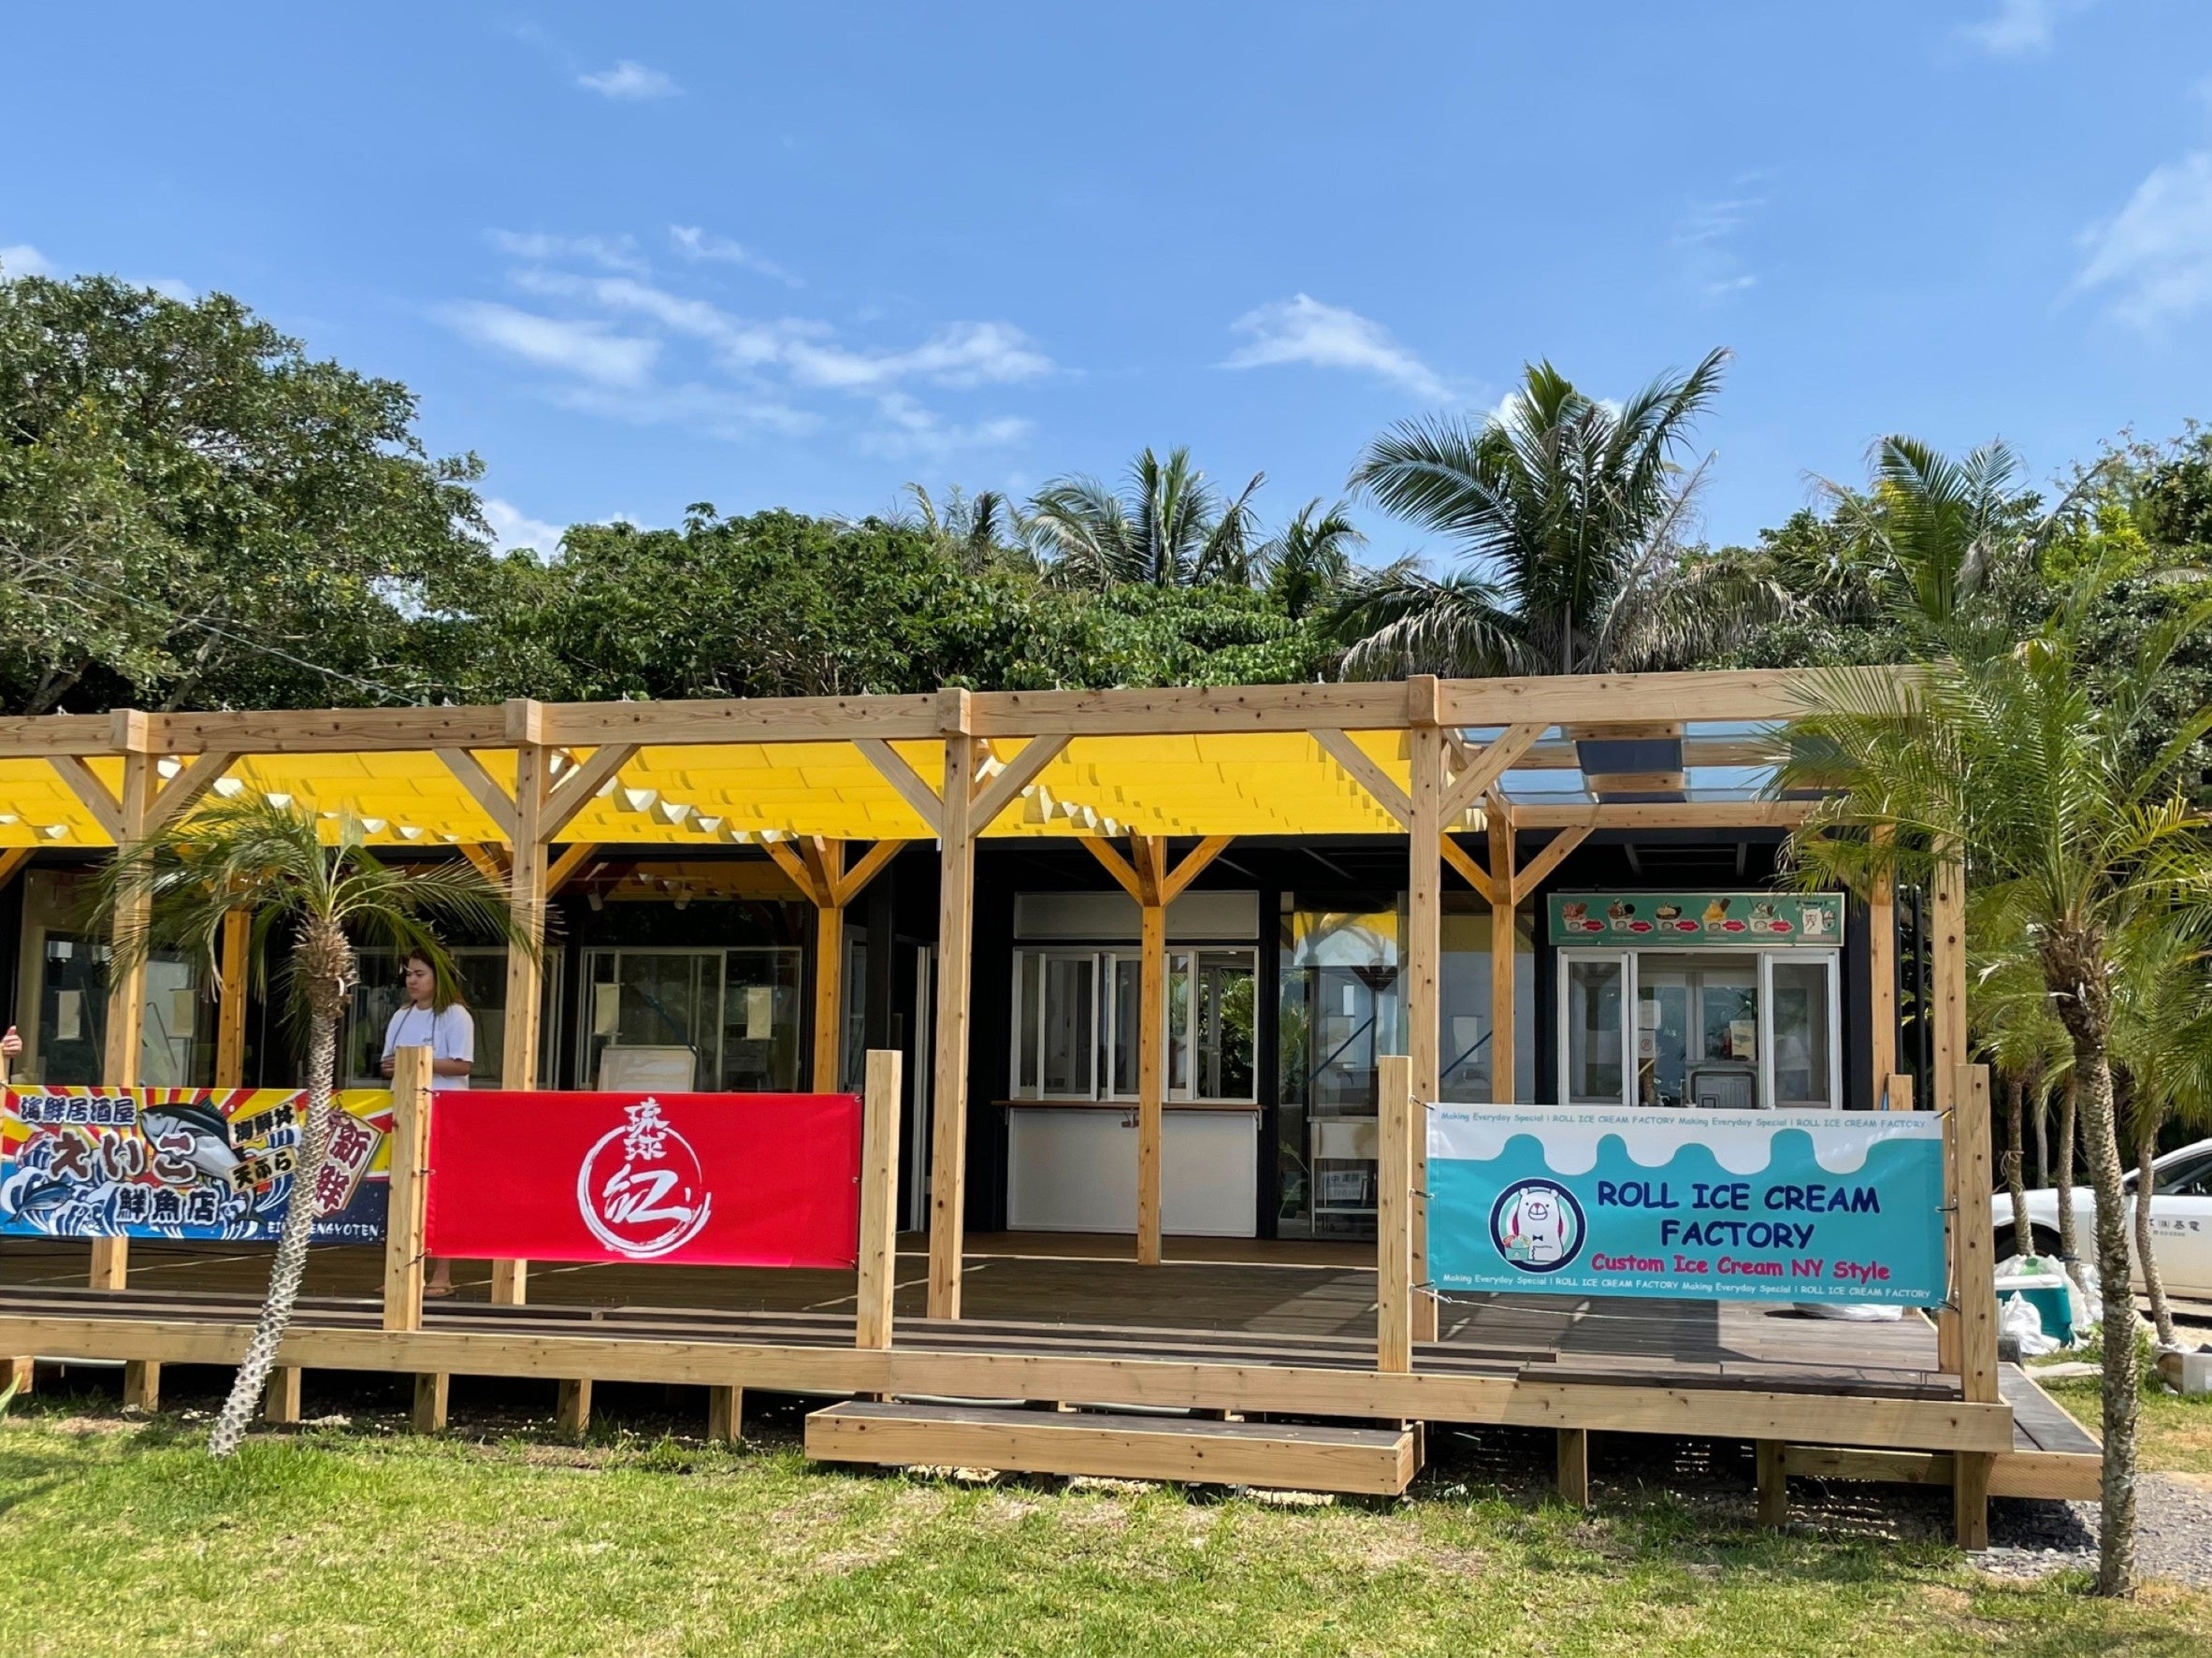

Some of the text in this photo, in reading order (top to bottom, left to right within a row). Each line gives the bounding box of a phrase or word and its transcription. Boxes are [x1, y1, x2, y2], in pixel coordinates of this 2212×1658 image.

[20, 1096, 136, 1123] 海鮮居酒屋
[1440, 1112, 1469, 1121] Making
[1473, 1113, 1511, 1122] Everyday
[1514, 1114, 1543, 1123] Special
[1632, 1116, 1675, 1124] FACTORY
[1678, 1117, 1708, 1126] Making
[1712, 1117, 1752, 1127] Everyday
[1757, 1118, 1786, 1128] Special
[1796, 1118, 1820, 1127] ROLL
[1824, 1119, 1840, 1128] ICE
[1844, 1119, 1876, 1128] CREAM
[1881, 1119, 1925, 1128] FACTORY
[50, 1130, 195, 1182] えいこ
[315, 1117, 371, 1210] 新鮮
[115, 1186, 217, 1222] 鮮魚店
[1598, 1180, 1880, 1214] ROLL ICE CREAM
[1660, 1219, 1814, 1249] FACTORY
[1592, 1253, 1890, 1285] Custom Ice Cream NY Style
[1443, 1274, 1471, 1284] Making
[1475, 1275, 1512, 1285] Everyday
[1517, 1276, 1546, 1286] Special
[1582, 1278, 1598, 1287] ICE
[1601, 1278, 1633, 1288] CREAM
[1637, 1279, 1678, 1289] FACTORY
[1682, 1282, 1713, 1291] Making
[1715, 1283, 1756, 1292] Everyday
[1759, 1284, 1790, 1293] Special
[1801, 1286, 1824, 1294] ROLL
[1829, 1287, 1845, 1295] ICE
[1849, 1288, 1882, 1296] CREAM
[1885, 1289, 1930, 1298] FACTORY
